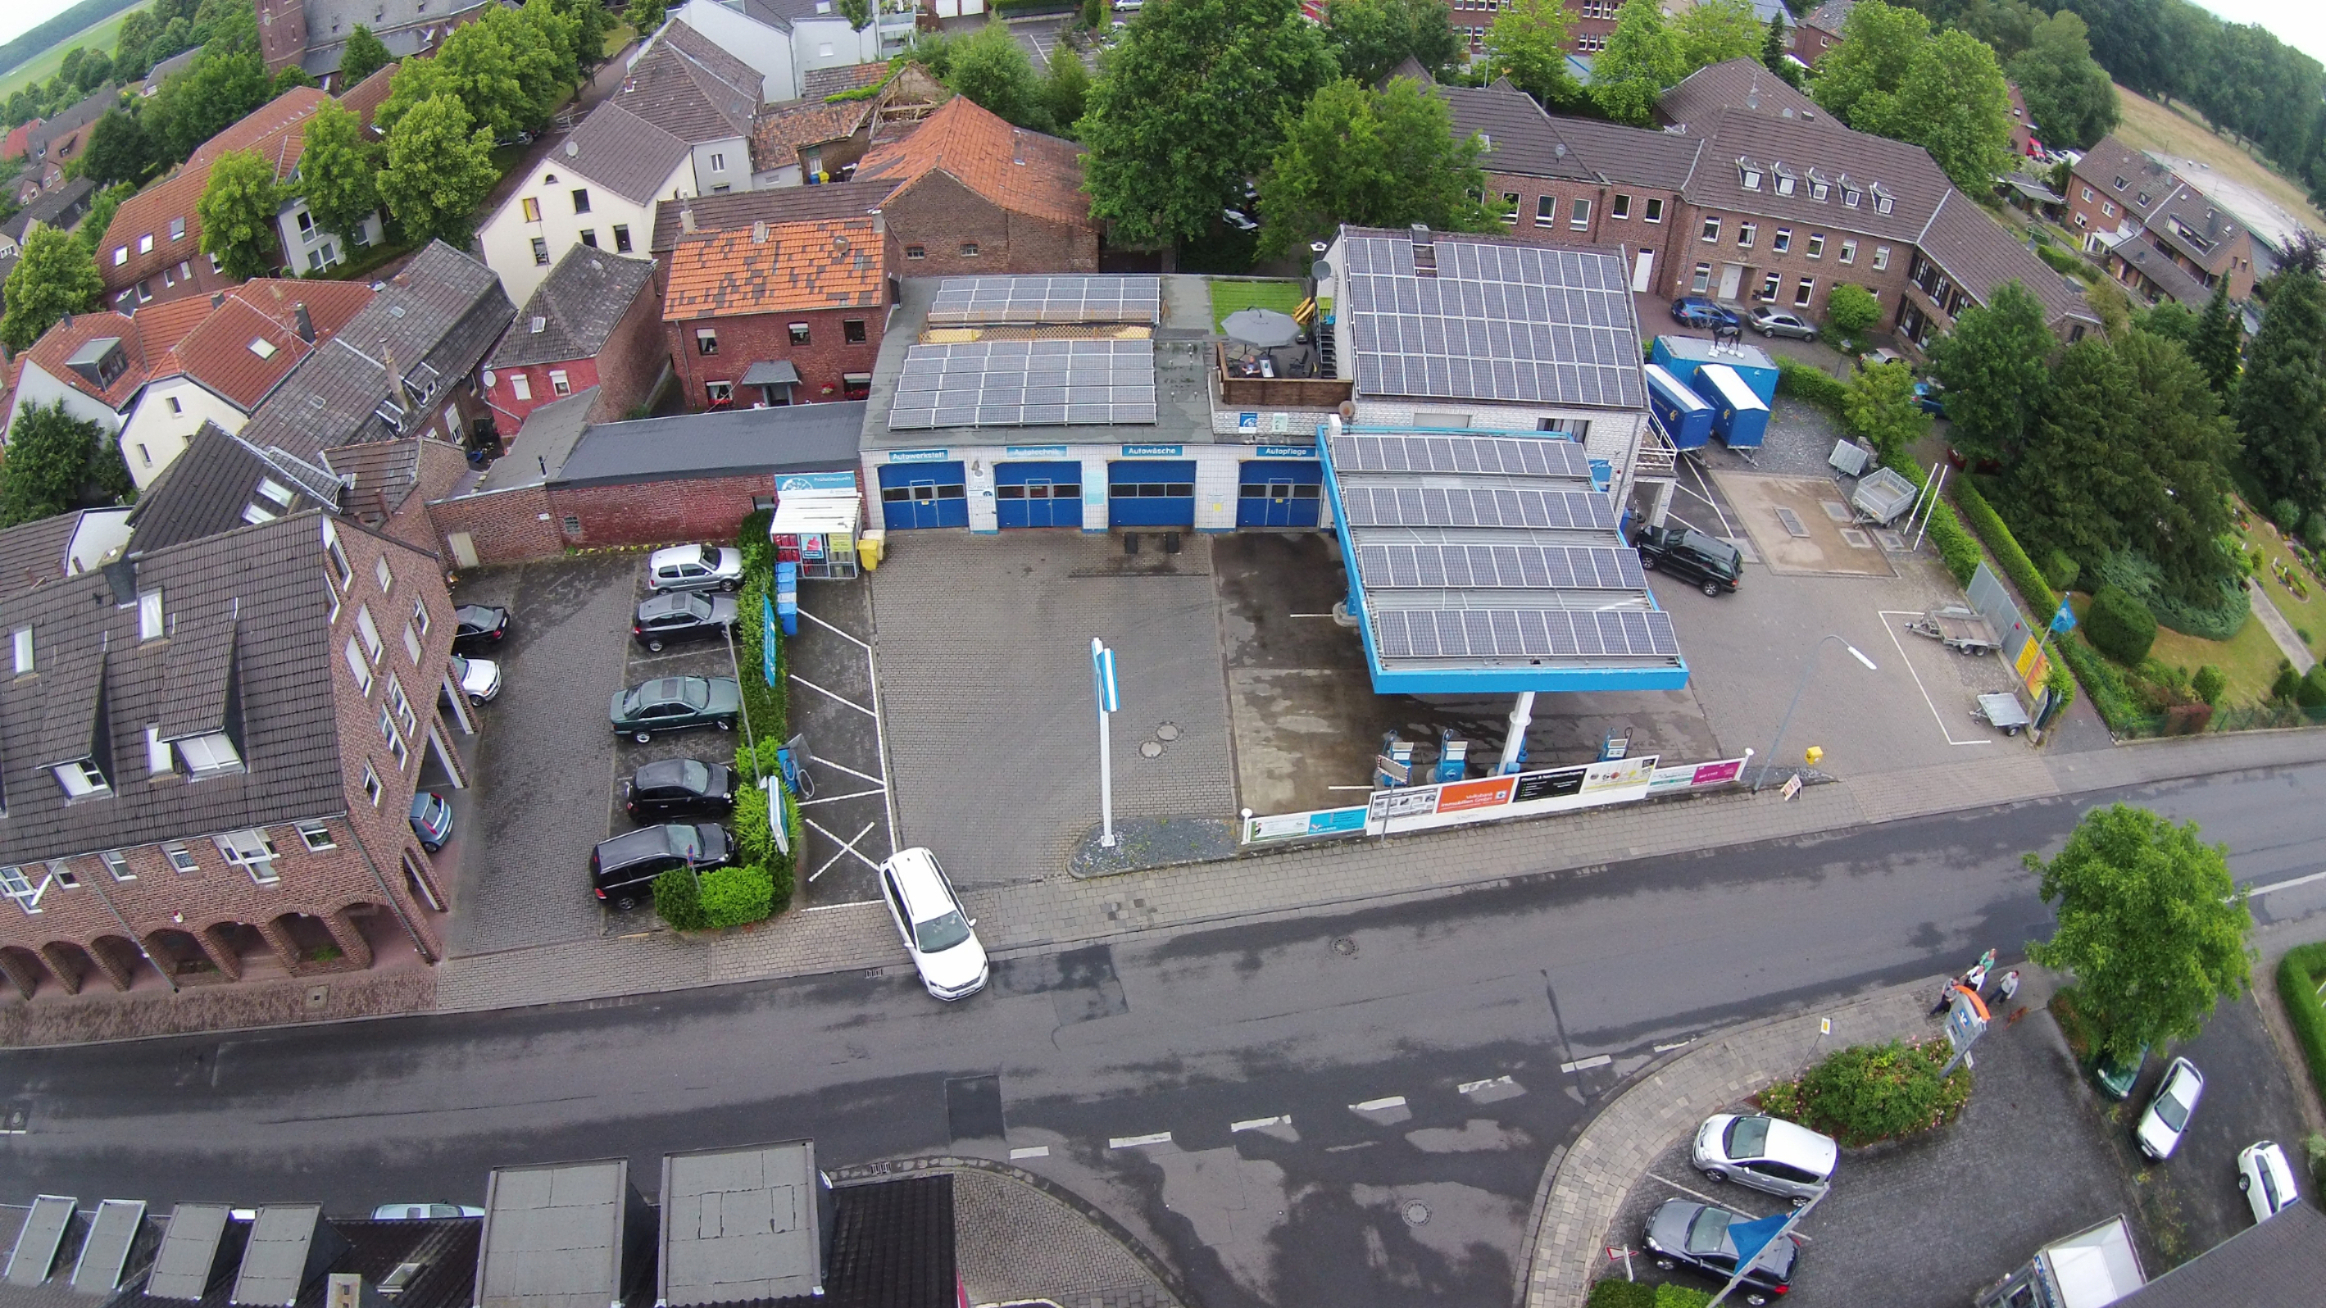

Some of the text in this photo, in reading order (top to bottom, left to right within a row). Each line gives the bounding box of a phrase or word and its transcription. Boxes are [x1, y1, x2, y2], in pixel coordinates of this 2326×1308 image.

[1014, 448, 1060, 456] Autotechnik
[1128, 446, 1176, 455] Autowäsche
[1265, 446, 1307, 456] Autopflege
[893, 452, 945, 460] Autowerkstatt
